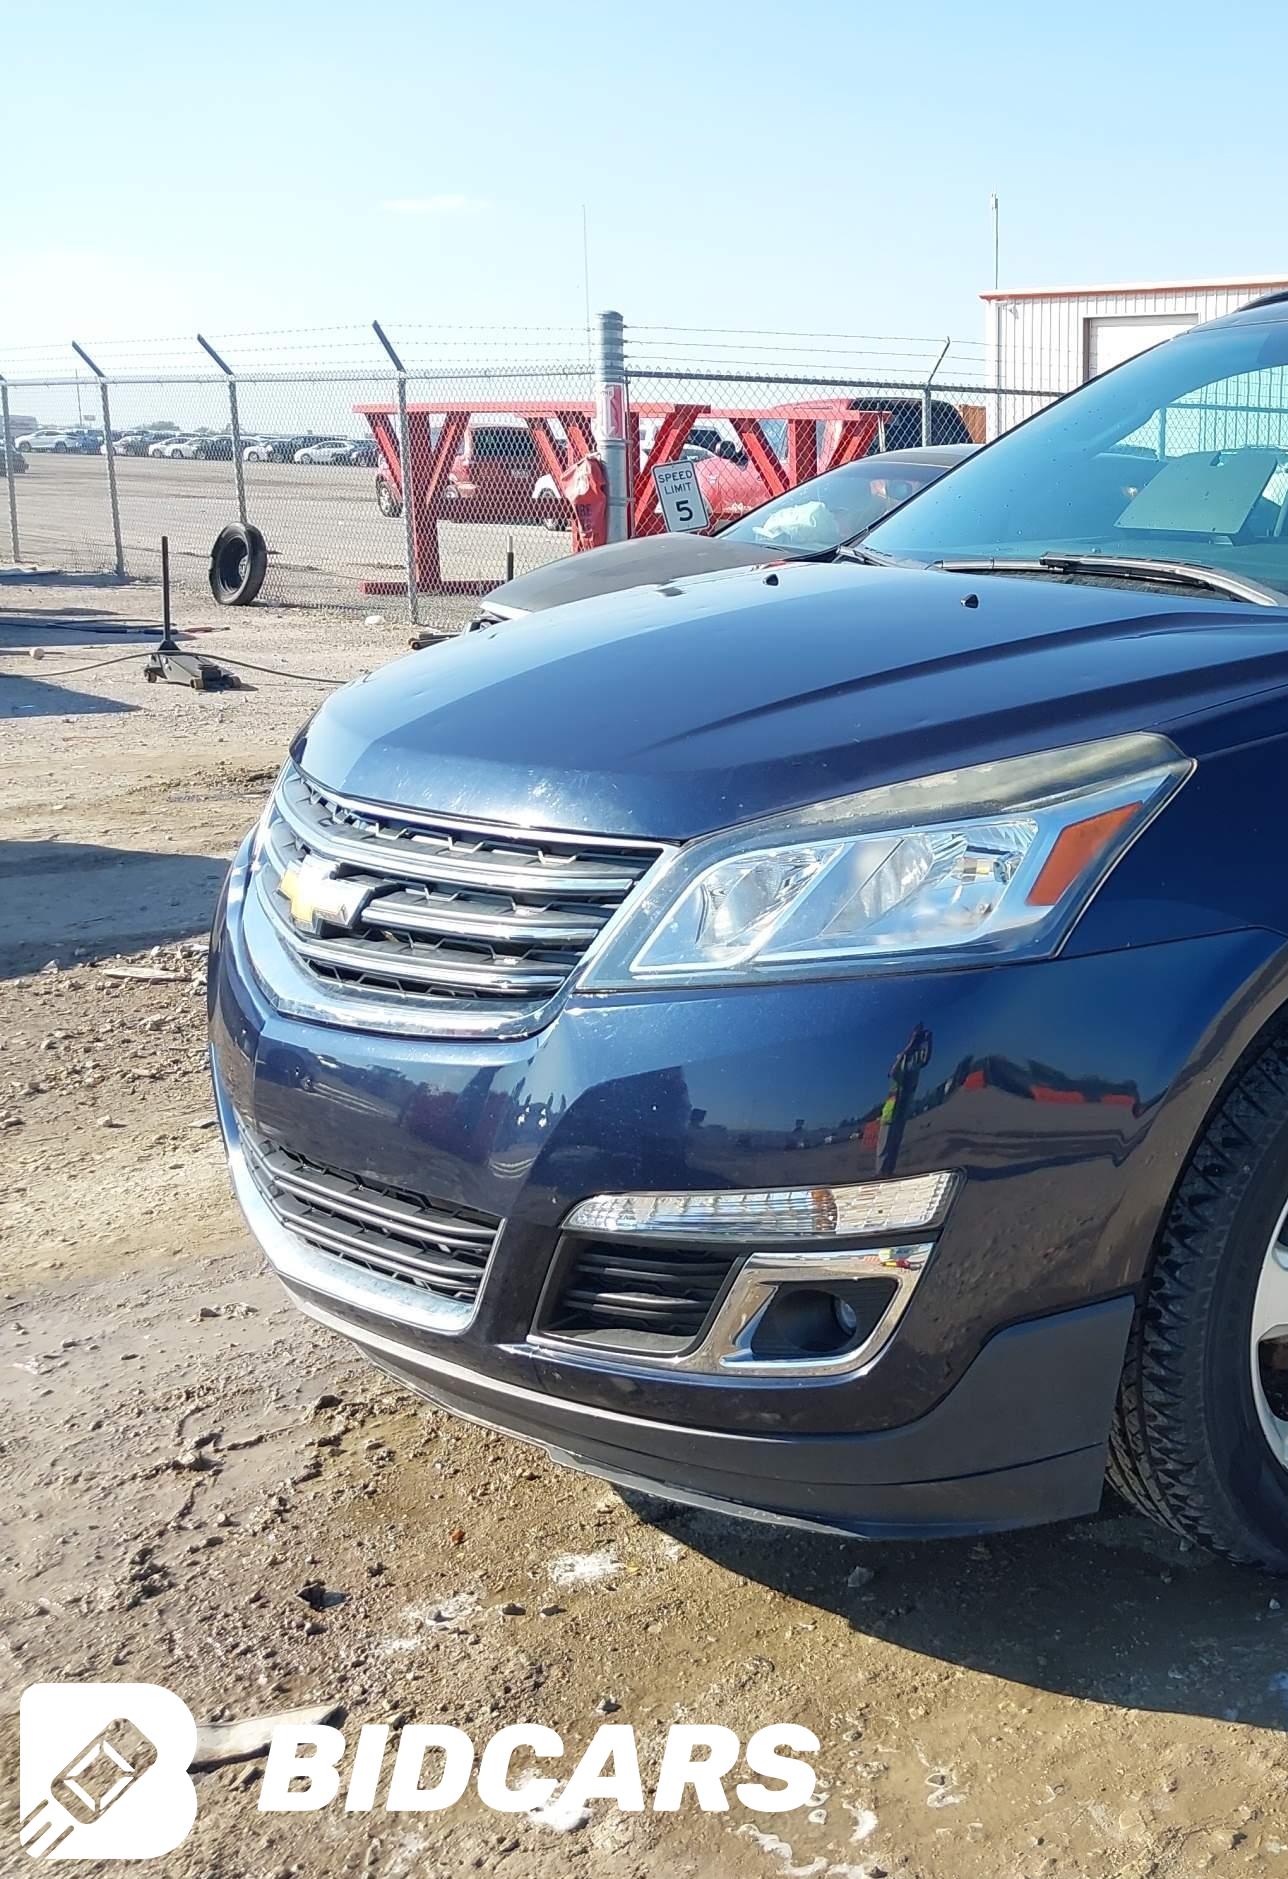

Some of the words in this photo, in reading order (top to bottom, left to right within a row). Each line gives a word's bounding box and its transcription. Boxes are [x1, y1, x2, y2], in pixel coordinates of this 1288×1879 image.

[658, 470, 692, 483] SPEED
[664, 482, 692, 495] LIMIT
[676, 500, 693, 521] 5
